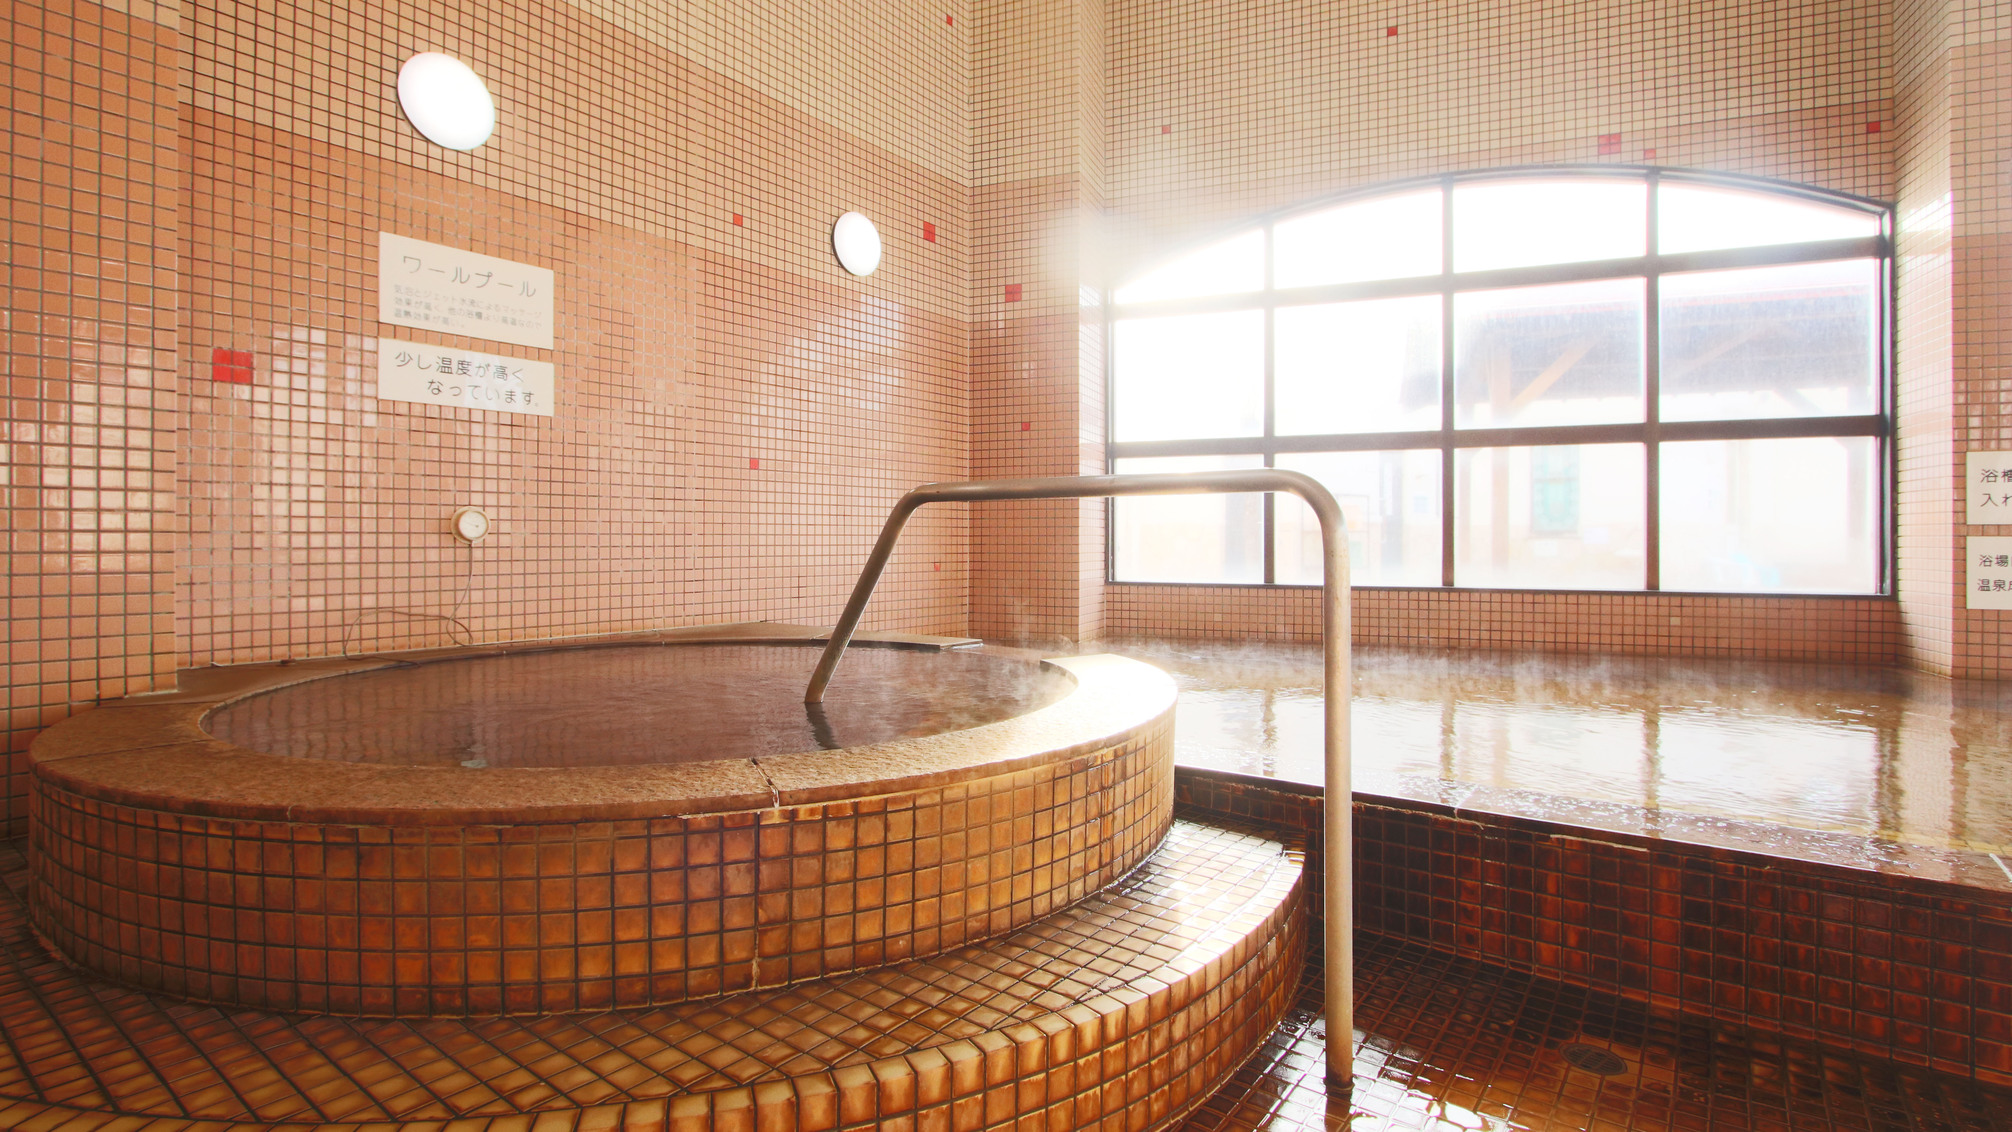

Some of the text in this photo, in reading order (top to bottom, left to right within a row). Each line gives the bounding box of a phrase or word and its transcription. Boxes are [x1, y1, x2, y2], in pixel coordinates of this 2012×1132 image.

[403, 255, 537, 298] ワールプール
[395, 351, 525, 383] 少し温度が高く
[427, 378, 539, 407] なっています。
[1978, 554, 2012, 568] 浴場
